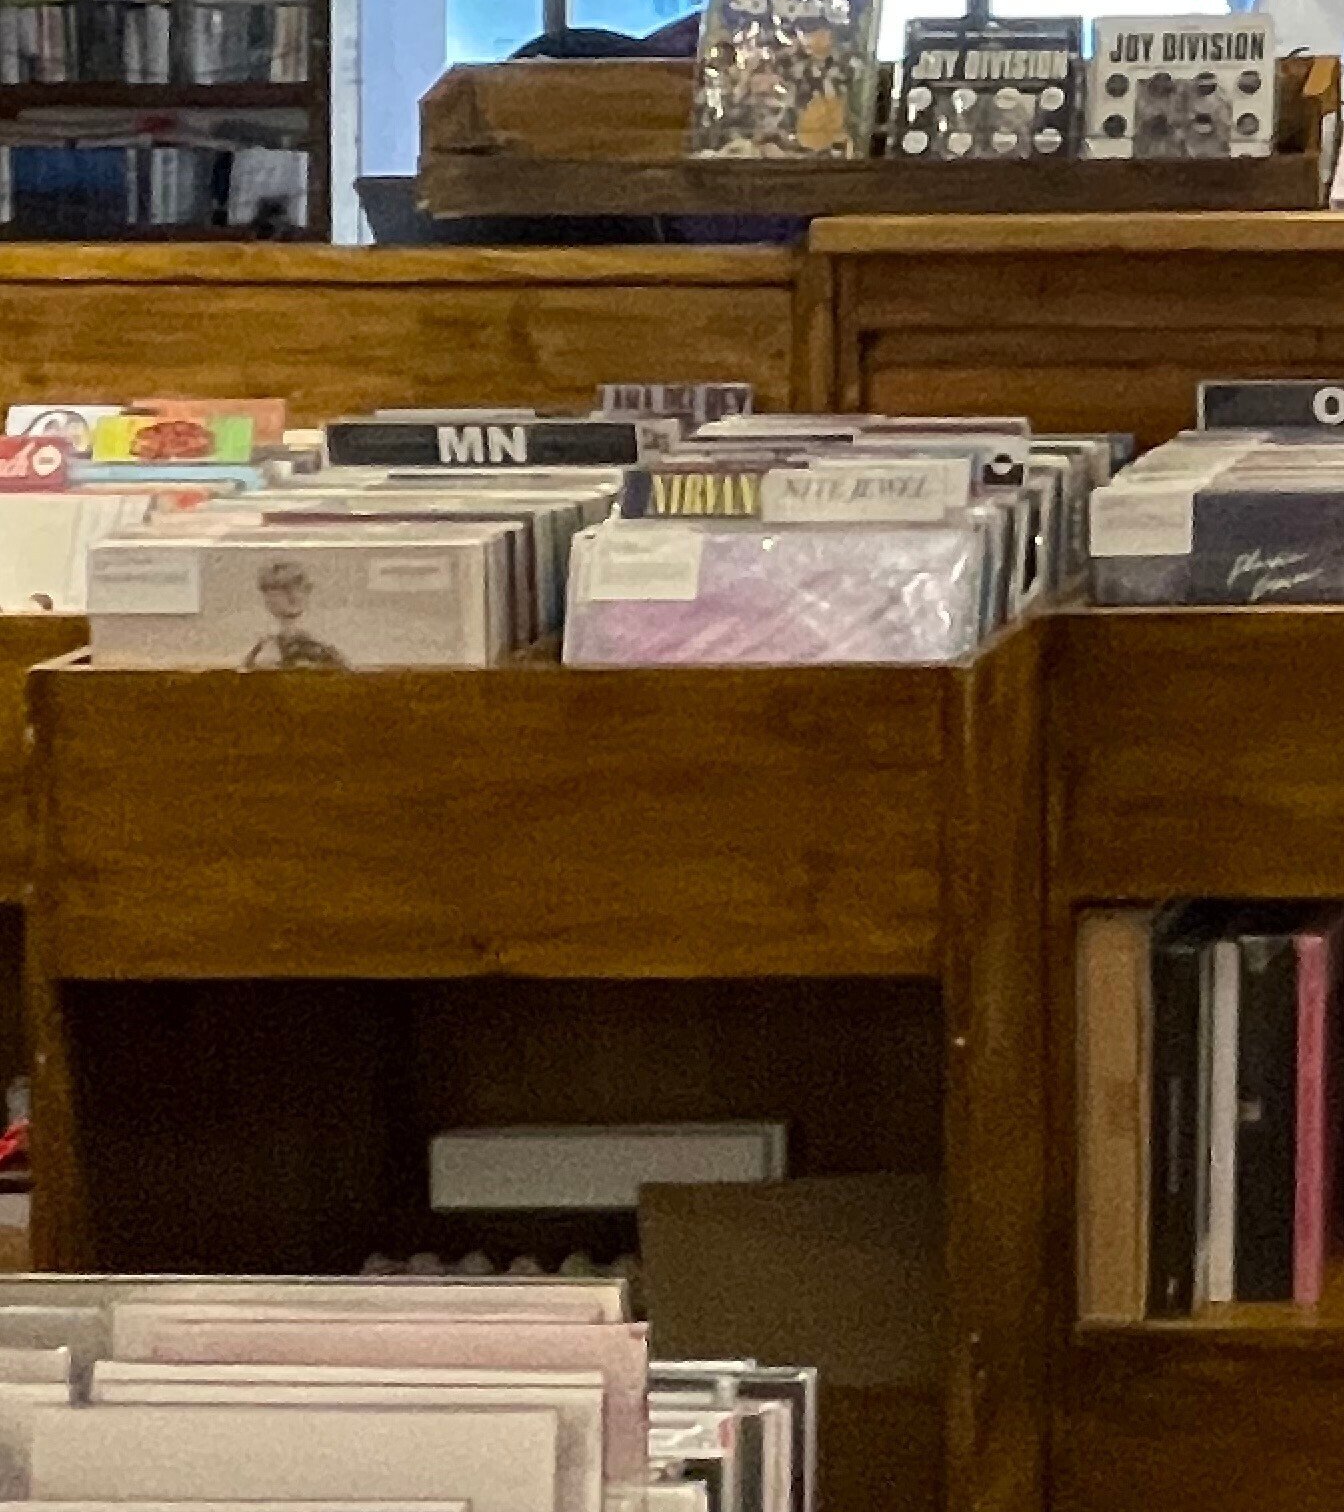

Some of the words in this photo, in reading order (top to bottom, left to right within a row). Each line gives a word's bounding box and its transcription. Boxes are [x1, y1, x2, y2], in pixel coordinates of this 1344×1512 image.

[1108, 33, 1156, 63] JOY
[1160, 31, 1266, 63] DIVISION
[911, 51, 957, 81] JOY
[962, 49, 1069, 80] DIVISION
[436, 426, 527, 464] MN
[651, 474, 760, 515] NIRVAN
